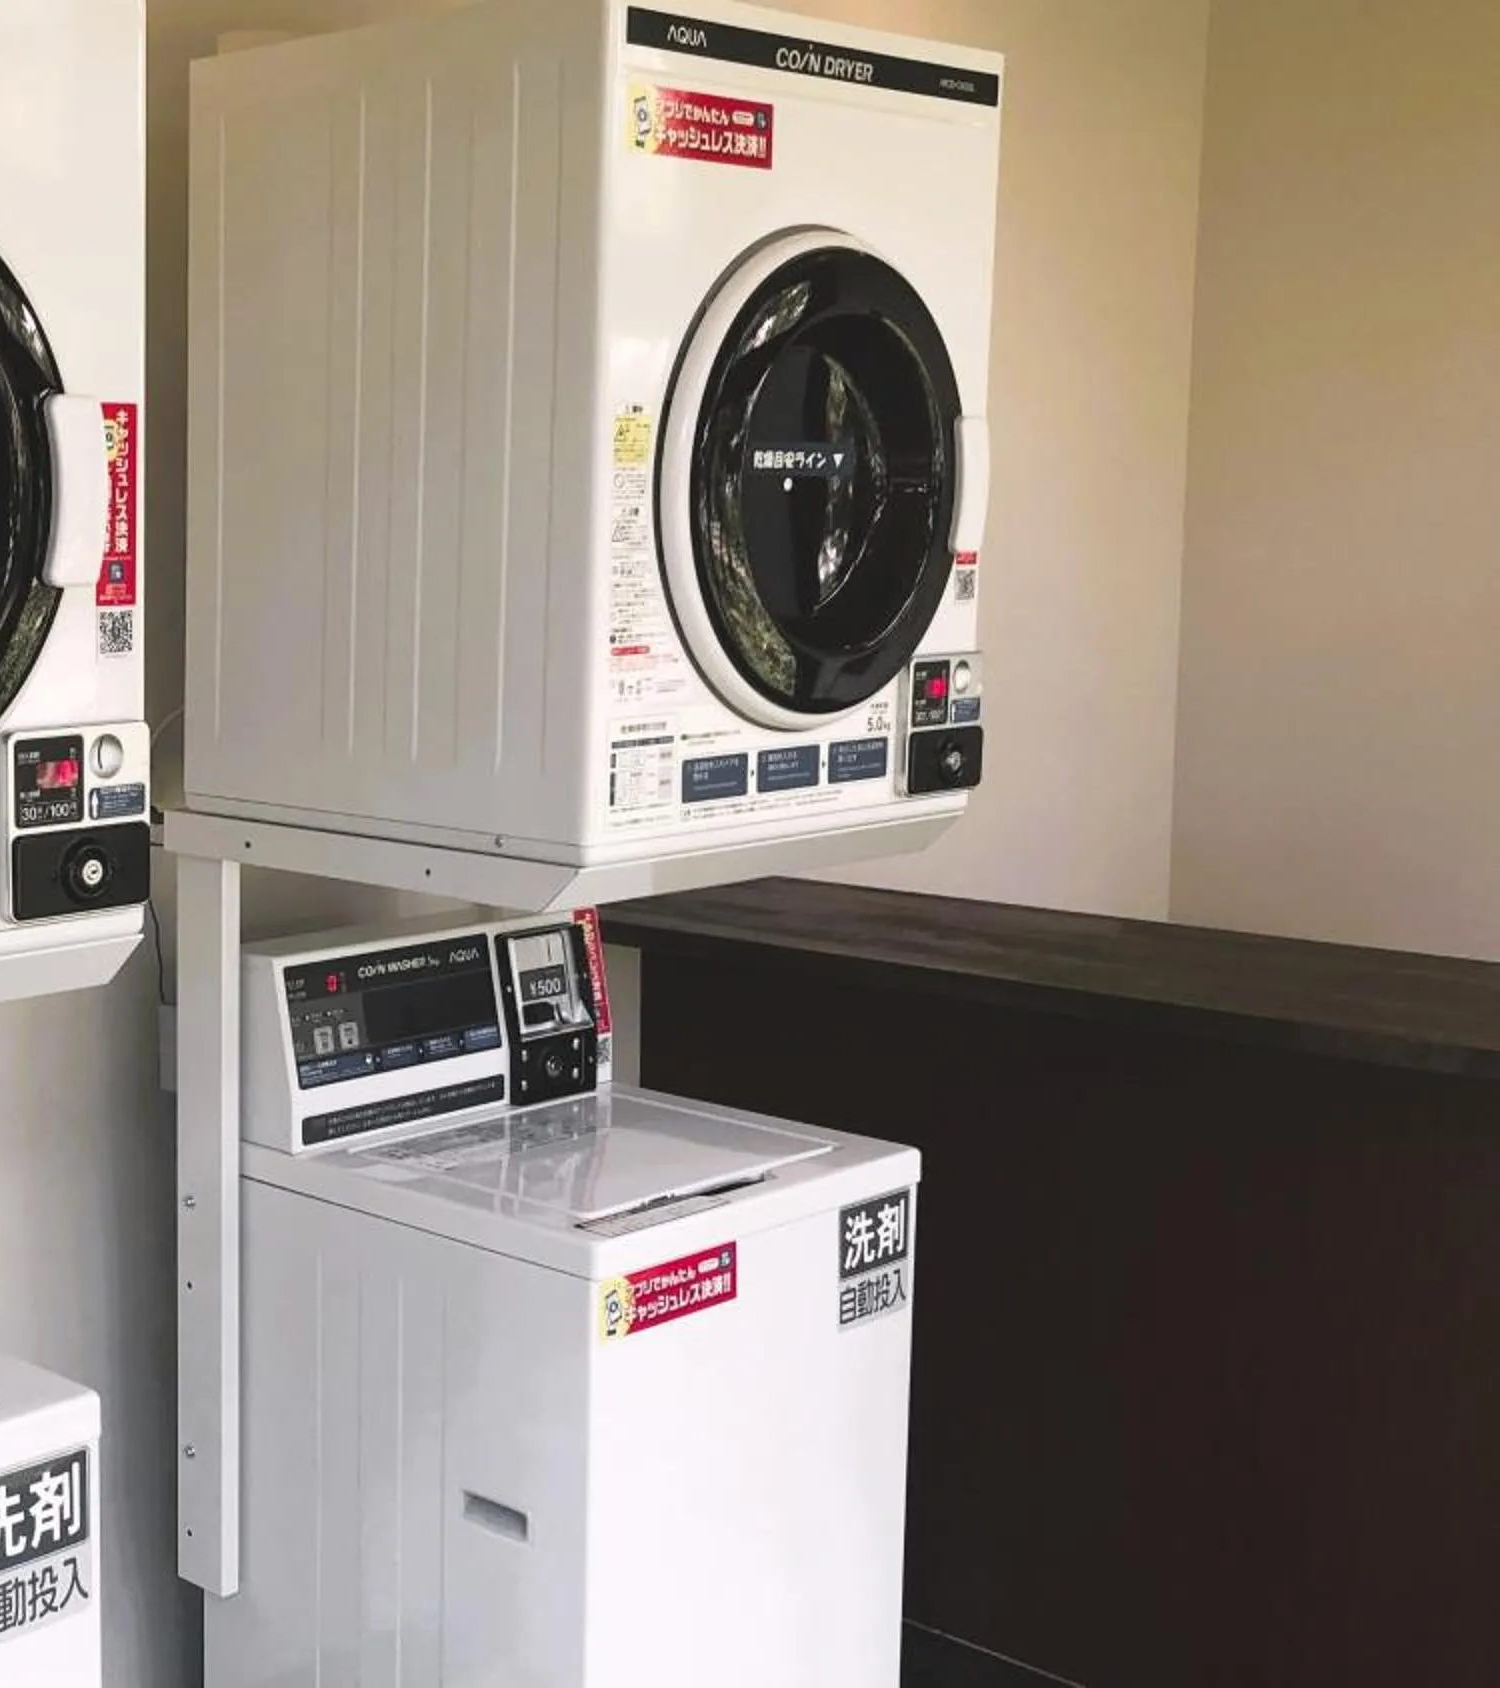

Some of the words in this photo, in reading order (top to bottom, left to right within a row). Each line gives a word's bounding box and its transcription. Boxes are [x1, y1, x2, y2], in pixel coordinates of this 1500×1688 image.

[667, 26, 706, 47] AQUA
[824, 55, 873, 82] DRYER
[844, 1199, 905, 1269] 洗剤
[839, 1267, 906, 1325] 自動投入
